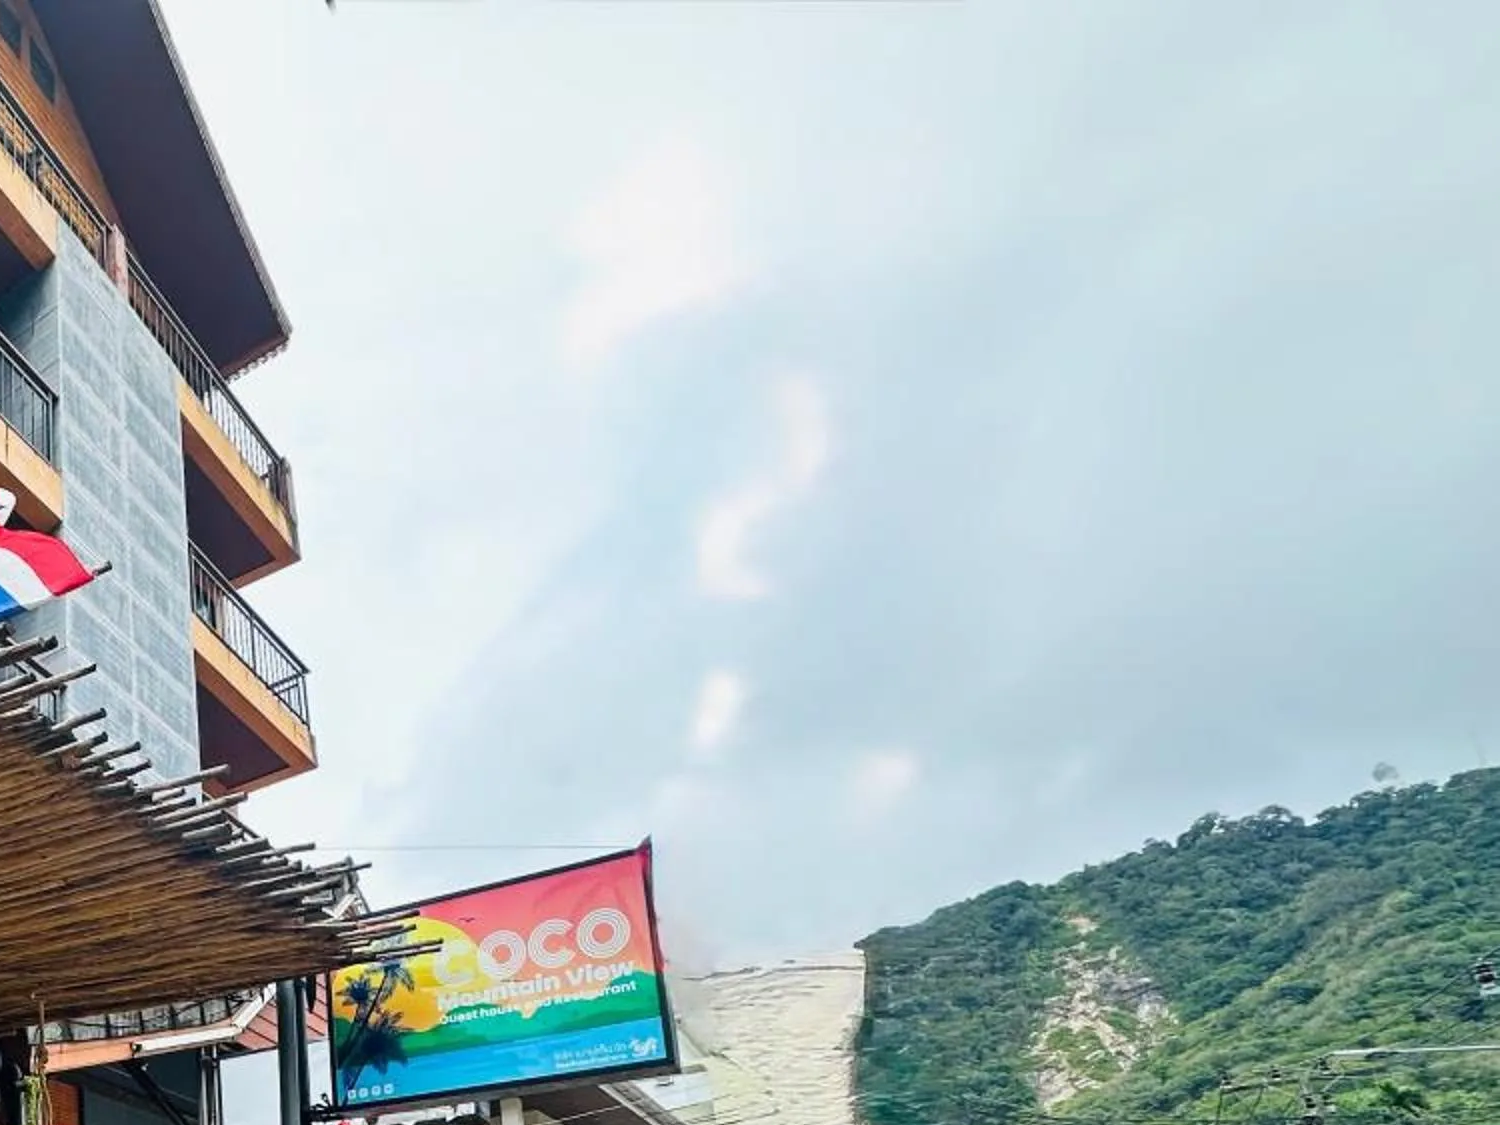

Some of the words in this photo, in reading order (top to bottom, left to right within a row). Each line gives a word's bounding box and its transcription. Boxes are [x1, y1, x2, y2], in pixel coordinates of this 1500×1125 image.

[433, 907, 631, 986] COCO
[565, 960, 635, 986] View
[480, 1004, 518, 1017] hou
